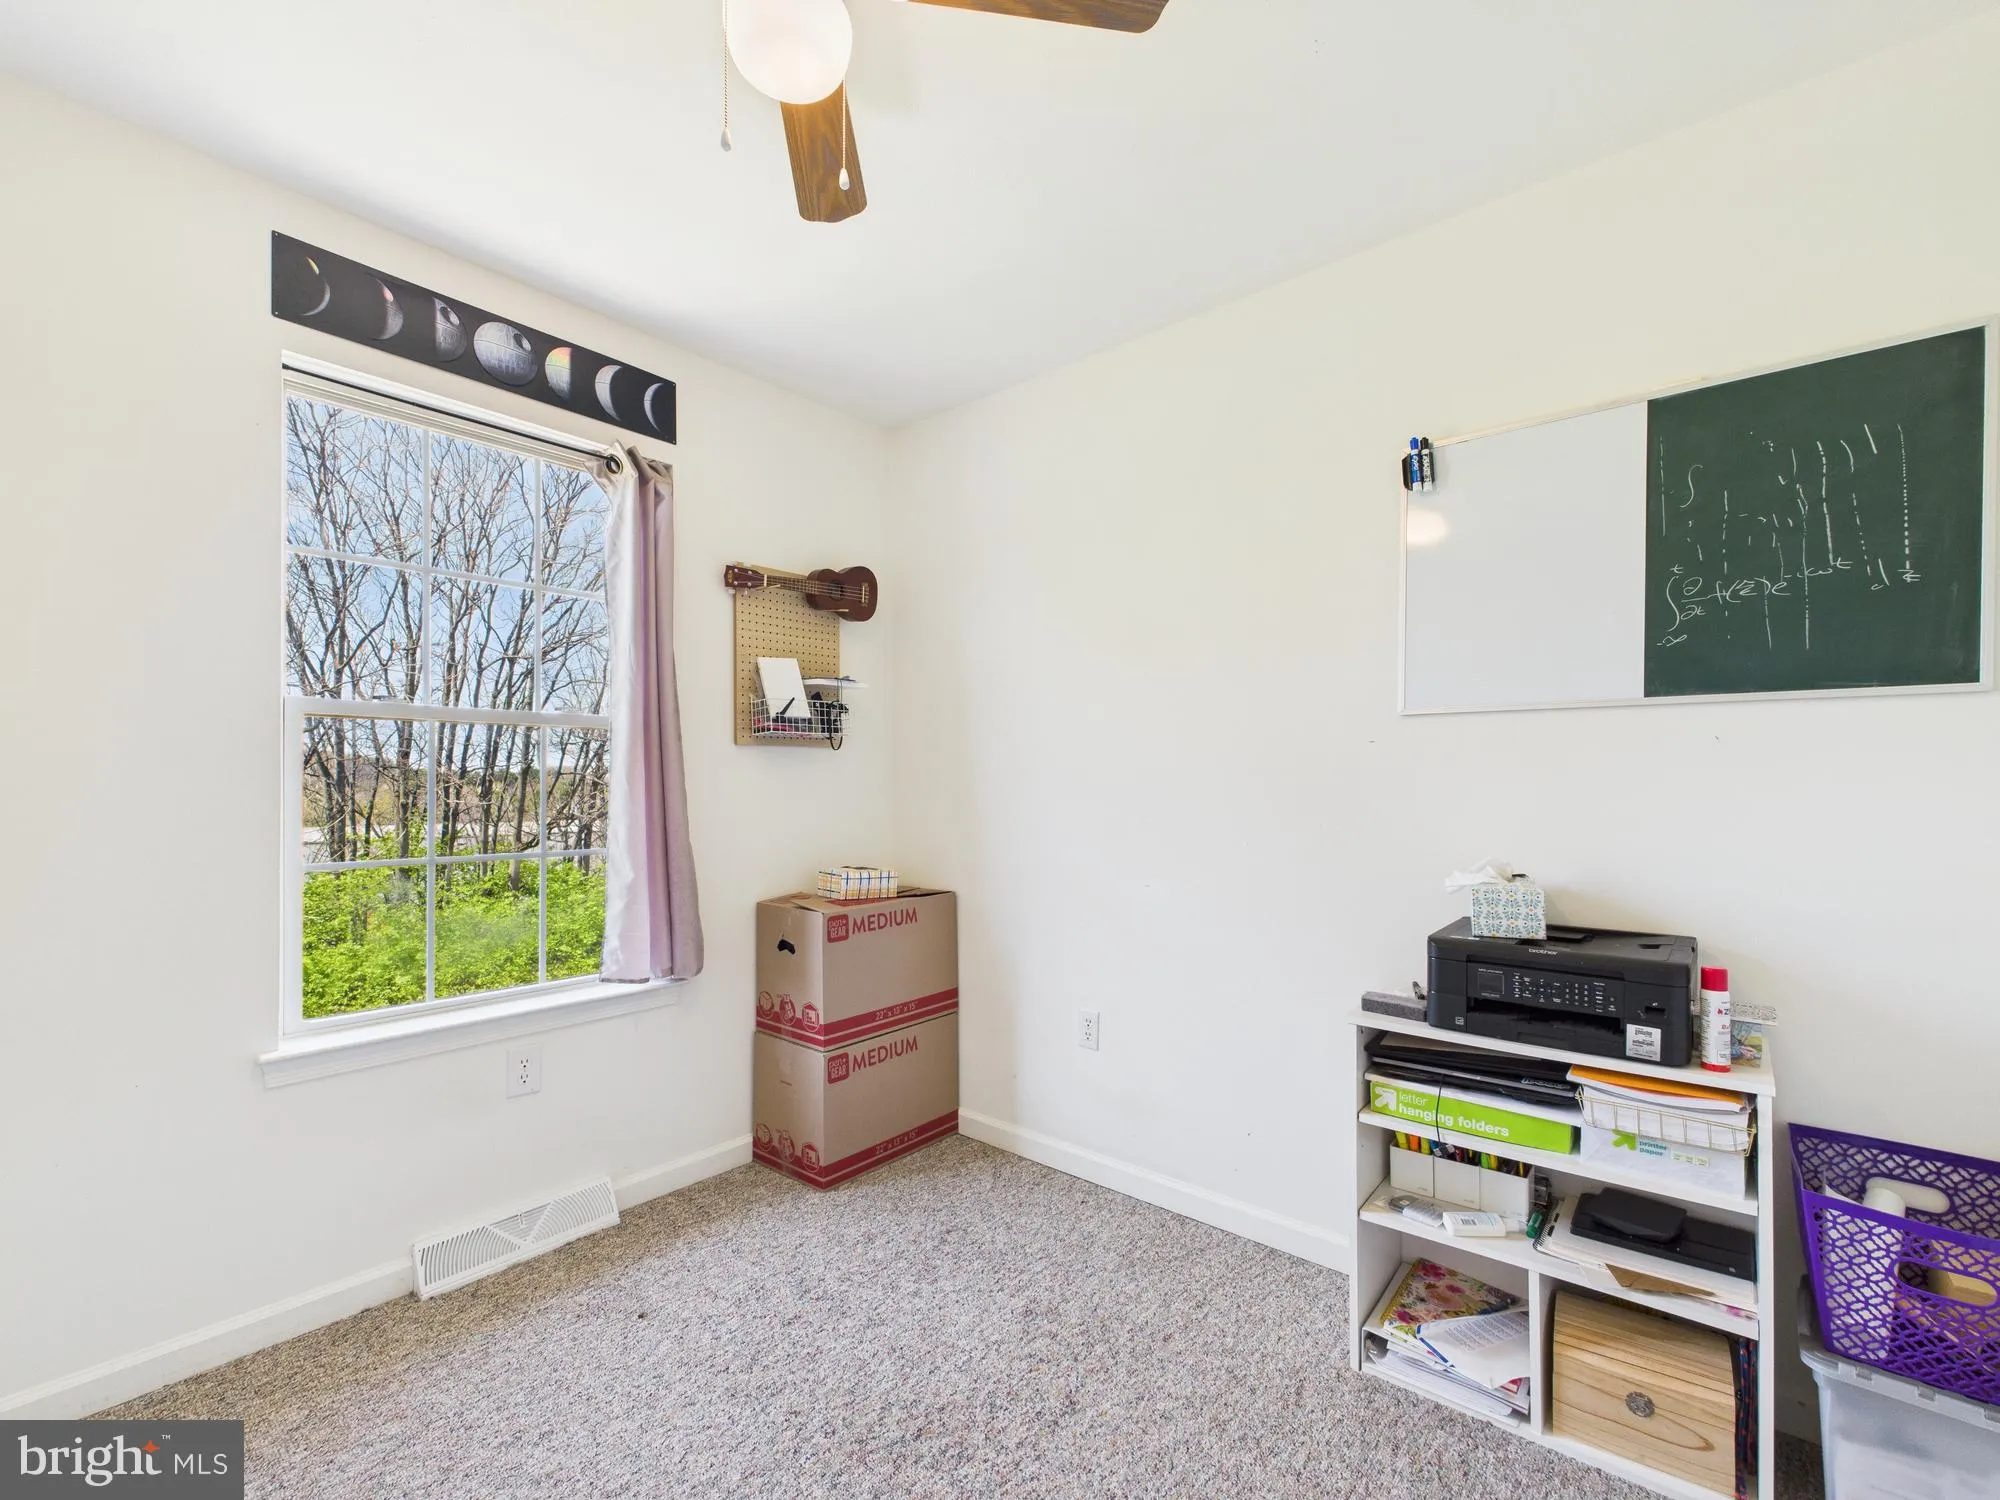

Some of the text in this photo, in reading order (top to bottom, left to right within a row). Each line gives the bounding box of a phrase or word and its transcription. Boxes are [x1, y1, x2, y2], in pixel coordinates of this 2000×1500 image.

[852, 906, 918, 935] MEDIUM
[1528, 948, 1559, 956] brother
[852, 1035, 919, 1073] MEDIUM
[1399, 1091, 1428, 1106] letter
[1398, 1103, 1510, 1137] hanging folders
[1639, 1140, 1668, 1151] printer
[1639, 1147, 1664, 1157] paper
